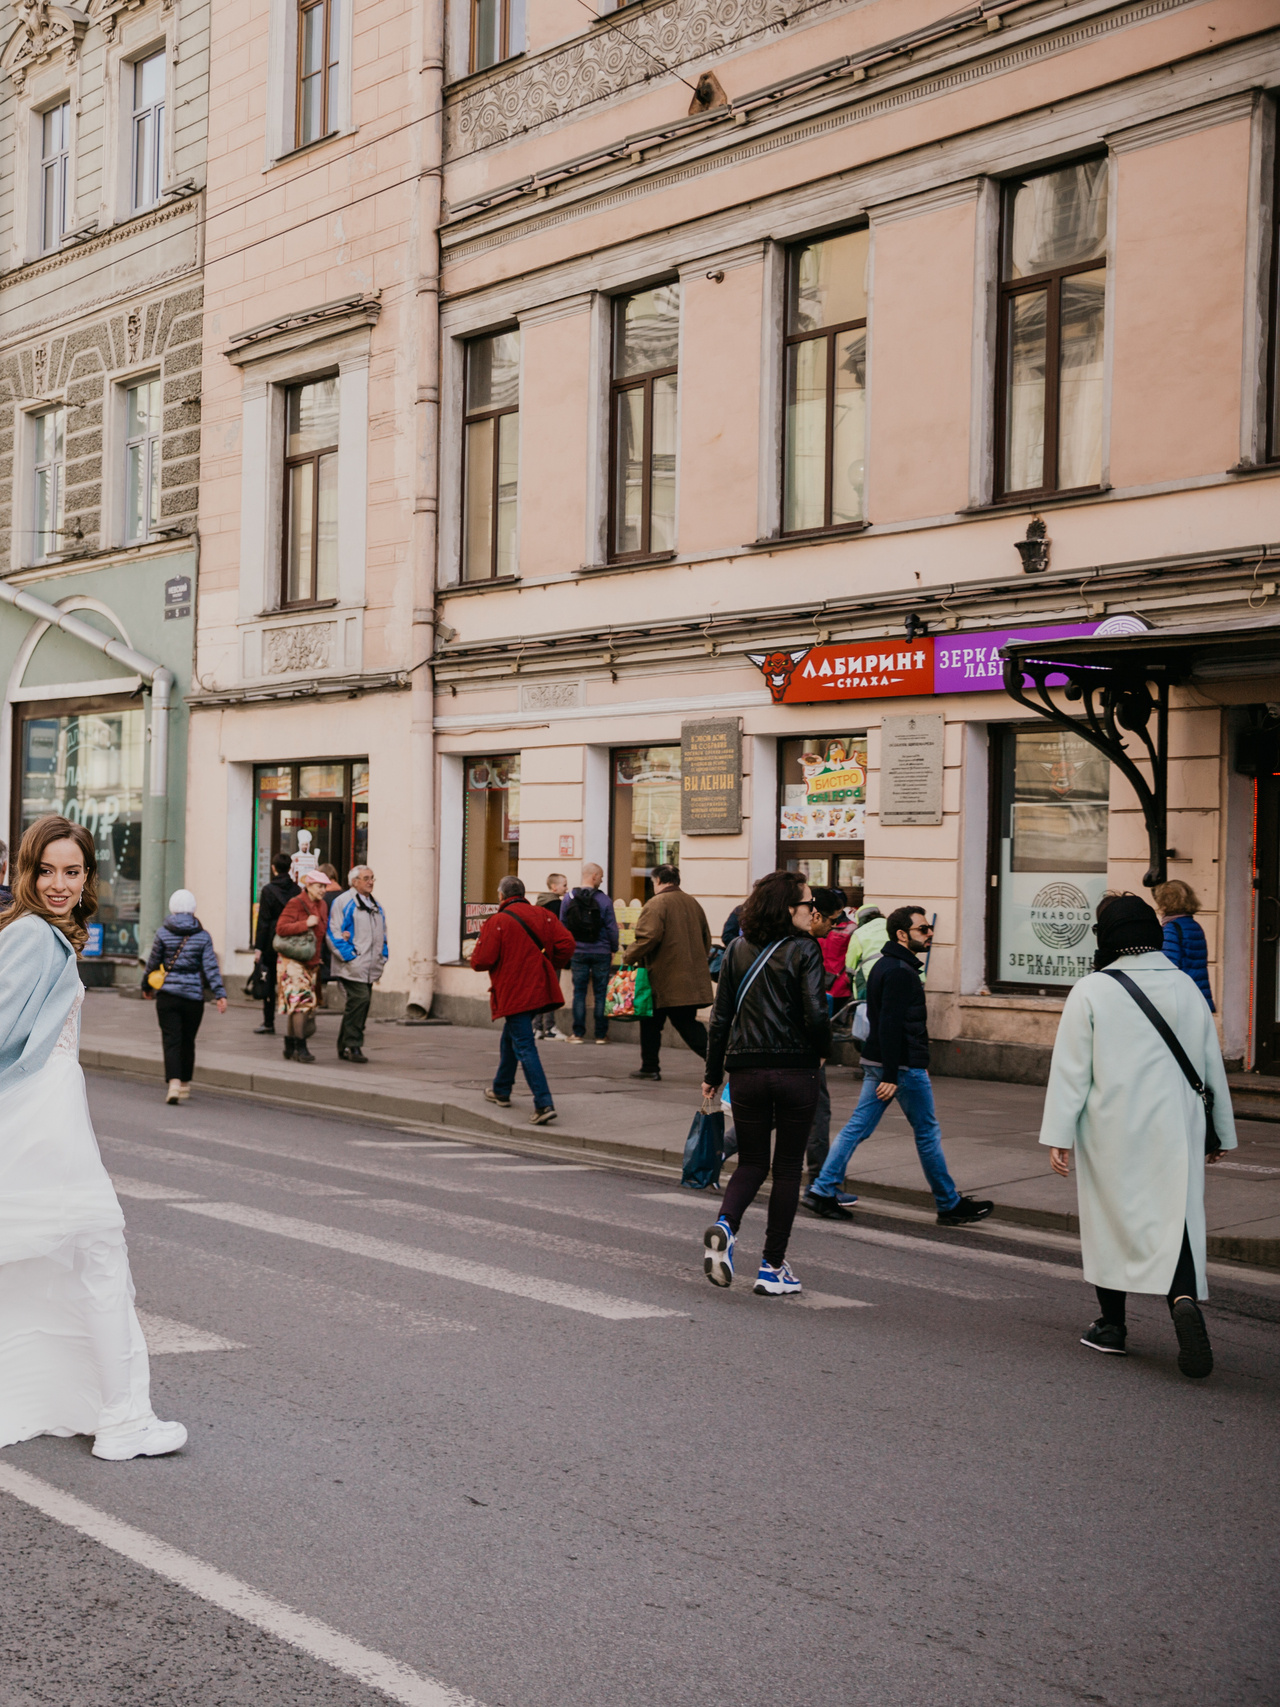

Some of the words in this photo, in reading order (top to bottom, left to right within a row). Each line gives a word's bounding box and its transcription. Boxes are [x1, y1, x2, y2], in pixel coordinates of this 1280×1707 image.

[802, 650, 926, 679] ЛАБИРИНТ
[939, 646, 1001, 669] ЗЕРКА
[837, 675, 889, 688] СТРАХА
[699, 773, 734, 791] ЛЕНИН
[814, 773, 859, 791] БИСТРО
[284, 817, 329, 829] БИСТРО
[1030, 910, 1091, 921] PIKABOLO
